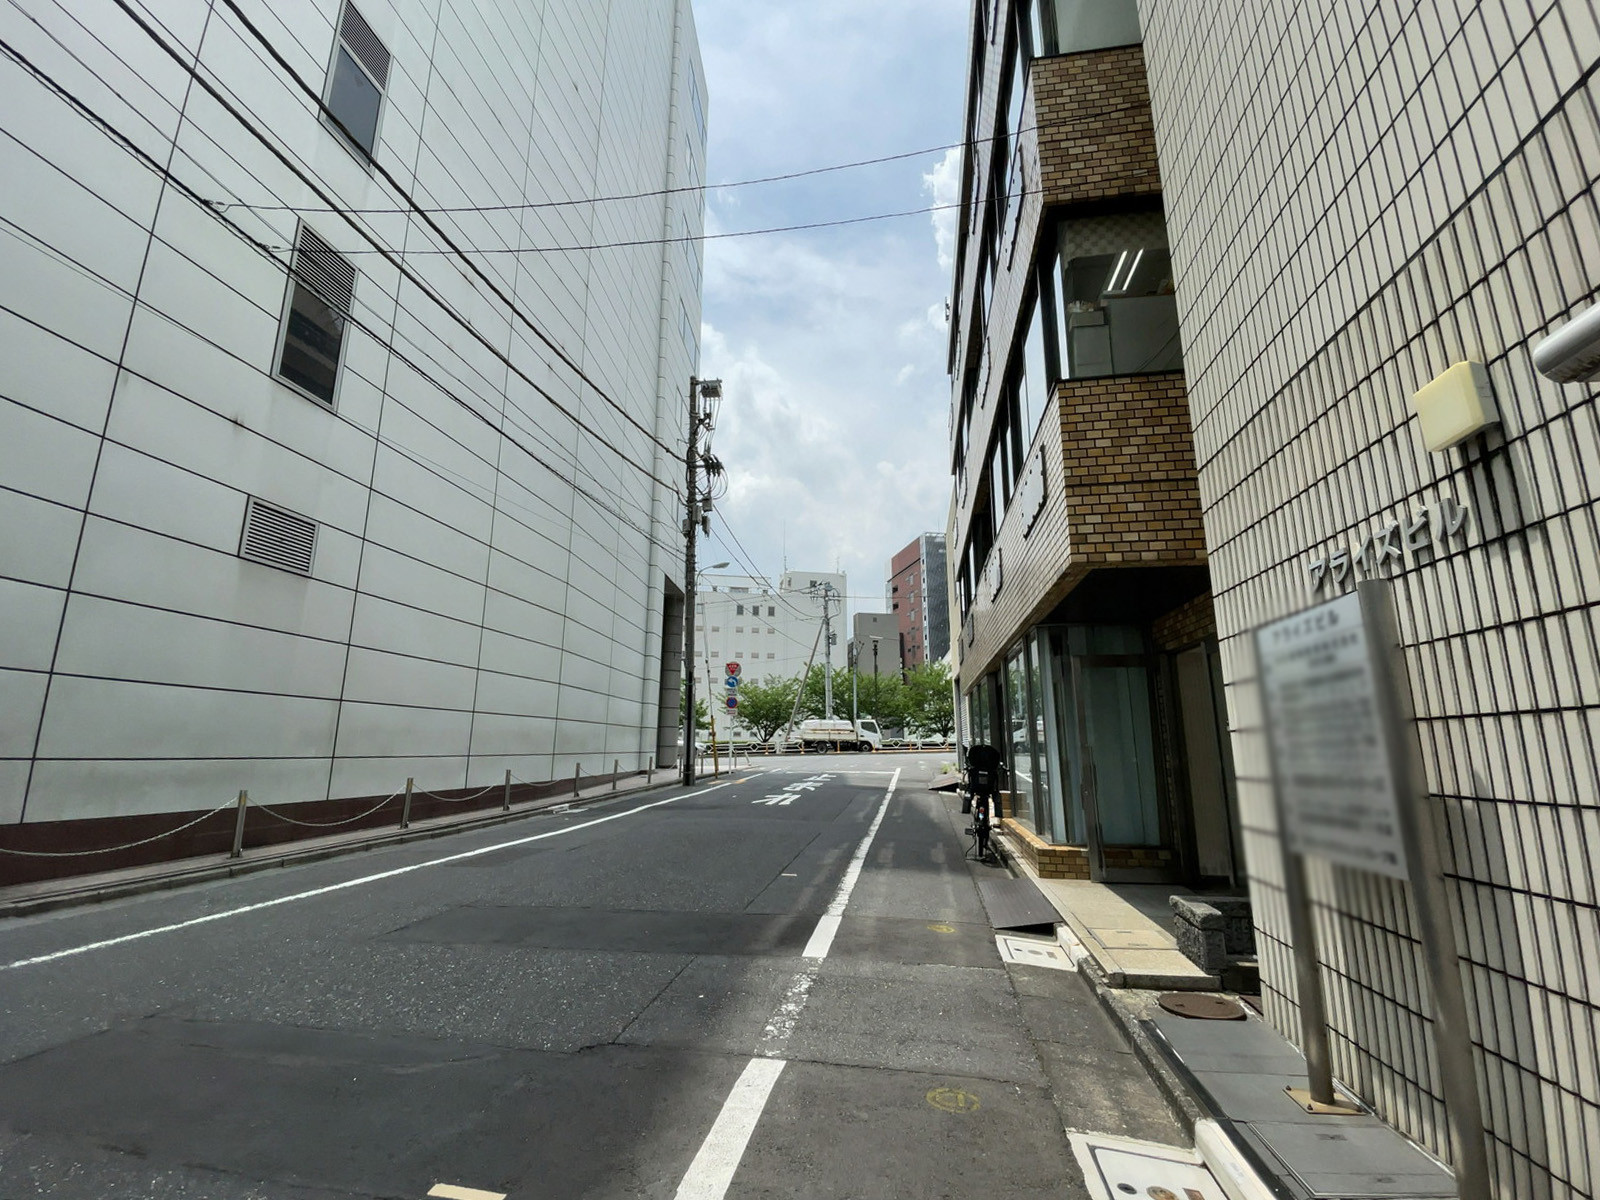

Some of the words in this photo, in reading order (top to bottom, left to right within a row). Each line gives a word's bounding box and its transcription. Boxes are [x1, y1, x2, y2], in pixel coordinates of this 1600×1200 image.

[1308, 498, 1467, 592] アライズビル
[751, 773, 837, 805] 止まれ
